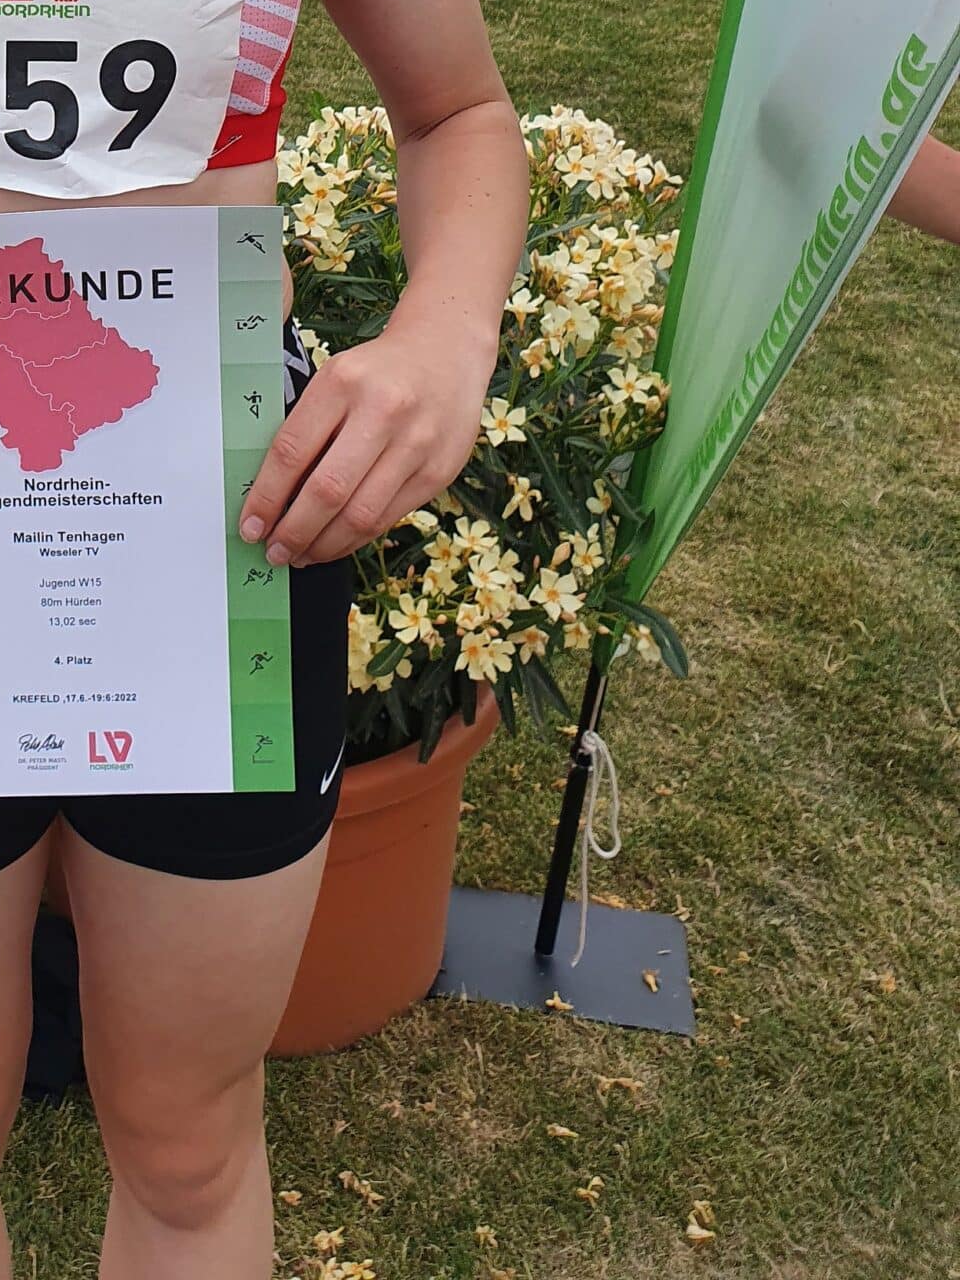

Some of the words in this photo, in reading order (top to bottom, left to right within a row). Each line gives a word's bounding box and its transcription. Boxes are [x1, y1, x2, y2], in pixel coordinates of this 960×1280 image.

[24, 477, 111, 492] Nordrhein-
[13, 531, 54, 543] Mailin
[58, 530, 125, 545] Tenhagen
[40, 547, 83, 557] Weseler
[85, 547, 100, 556] TV
[39, 578, 76, 589] Jugend
[78, 577, 102, 587] W15
[40, 597, 63, 607] 80m
[65, 597, 102, 607] Hürden
[49, 616, 76, 627] 13,02
[78, 618, 97, 626] sec
[54, 656, 64, 665] 4.
[66, 656, 93, 665] Platz
[12, 694, 61, 703] KREFELD
